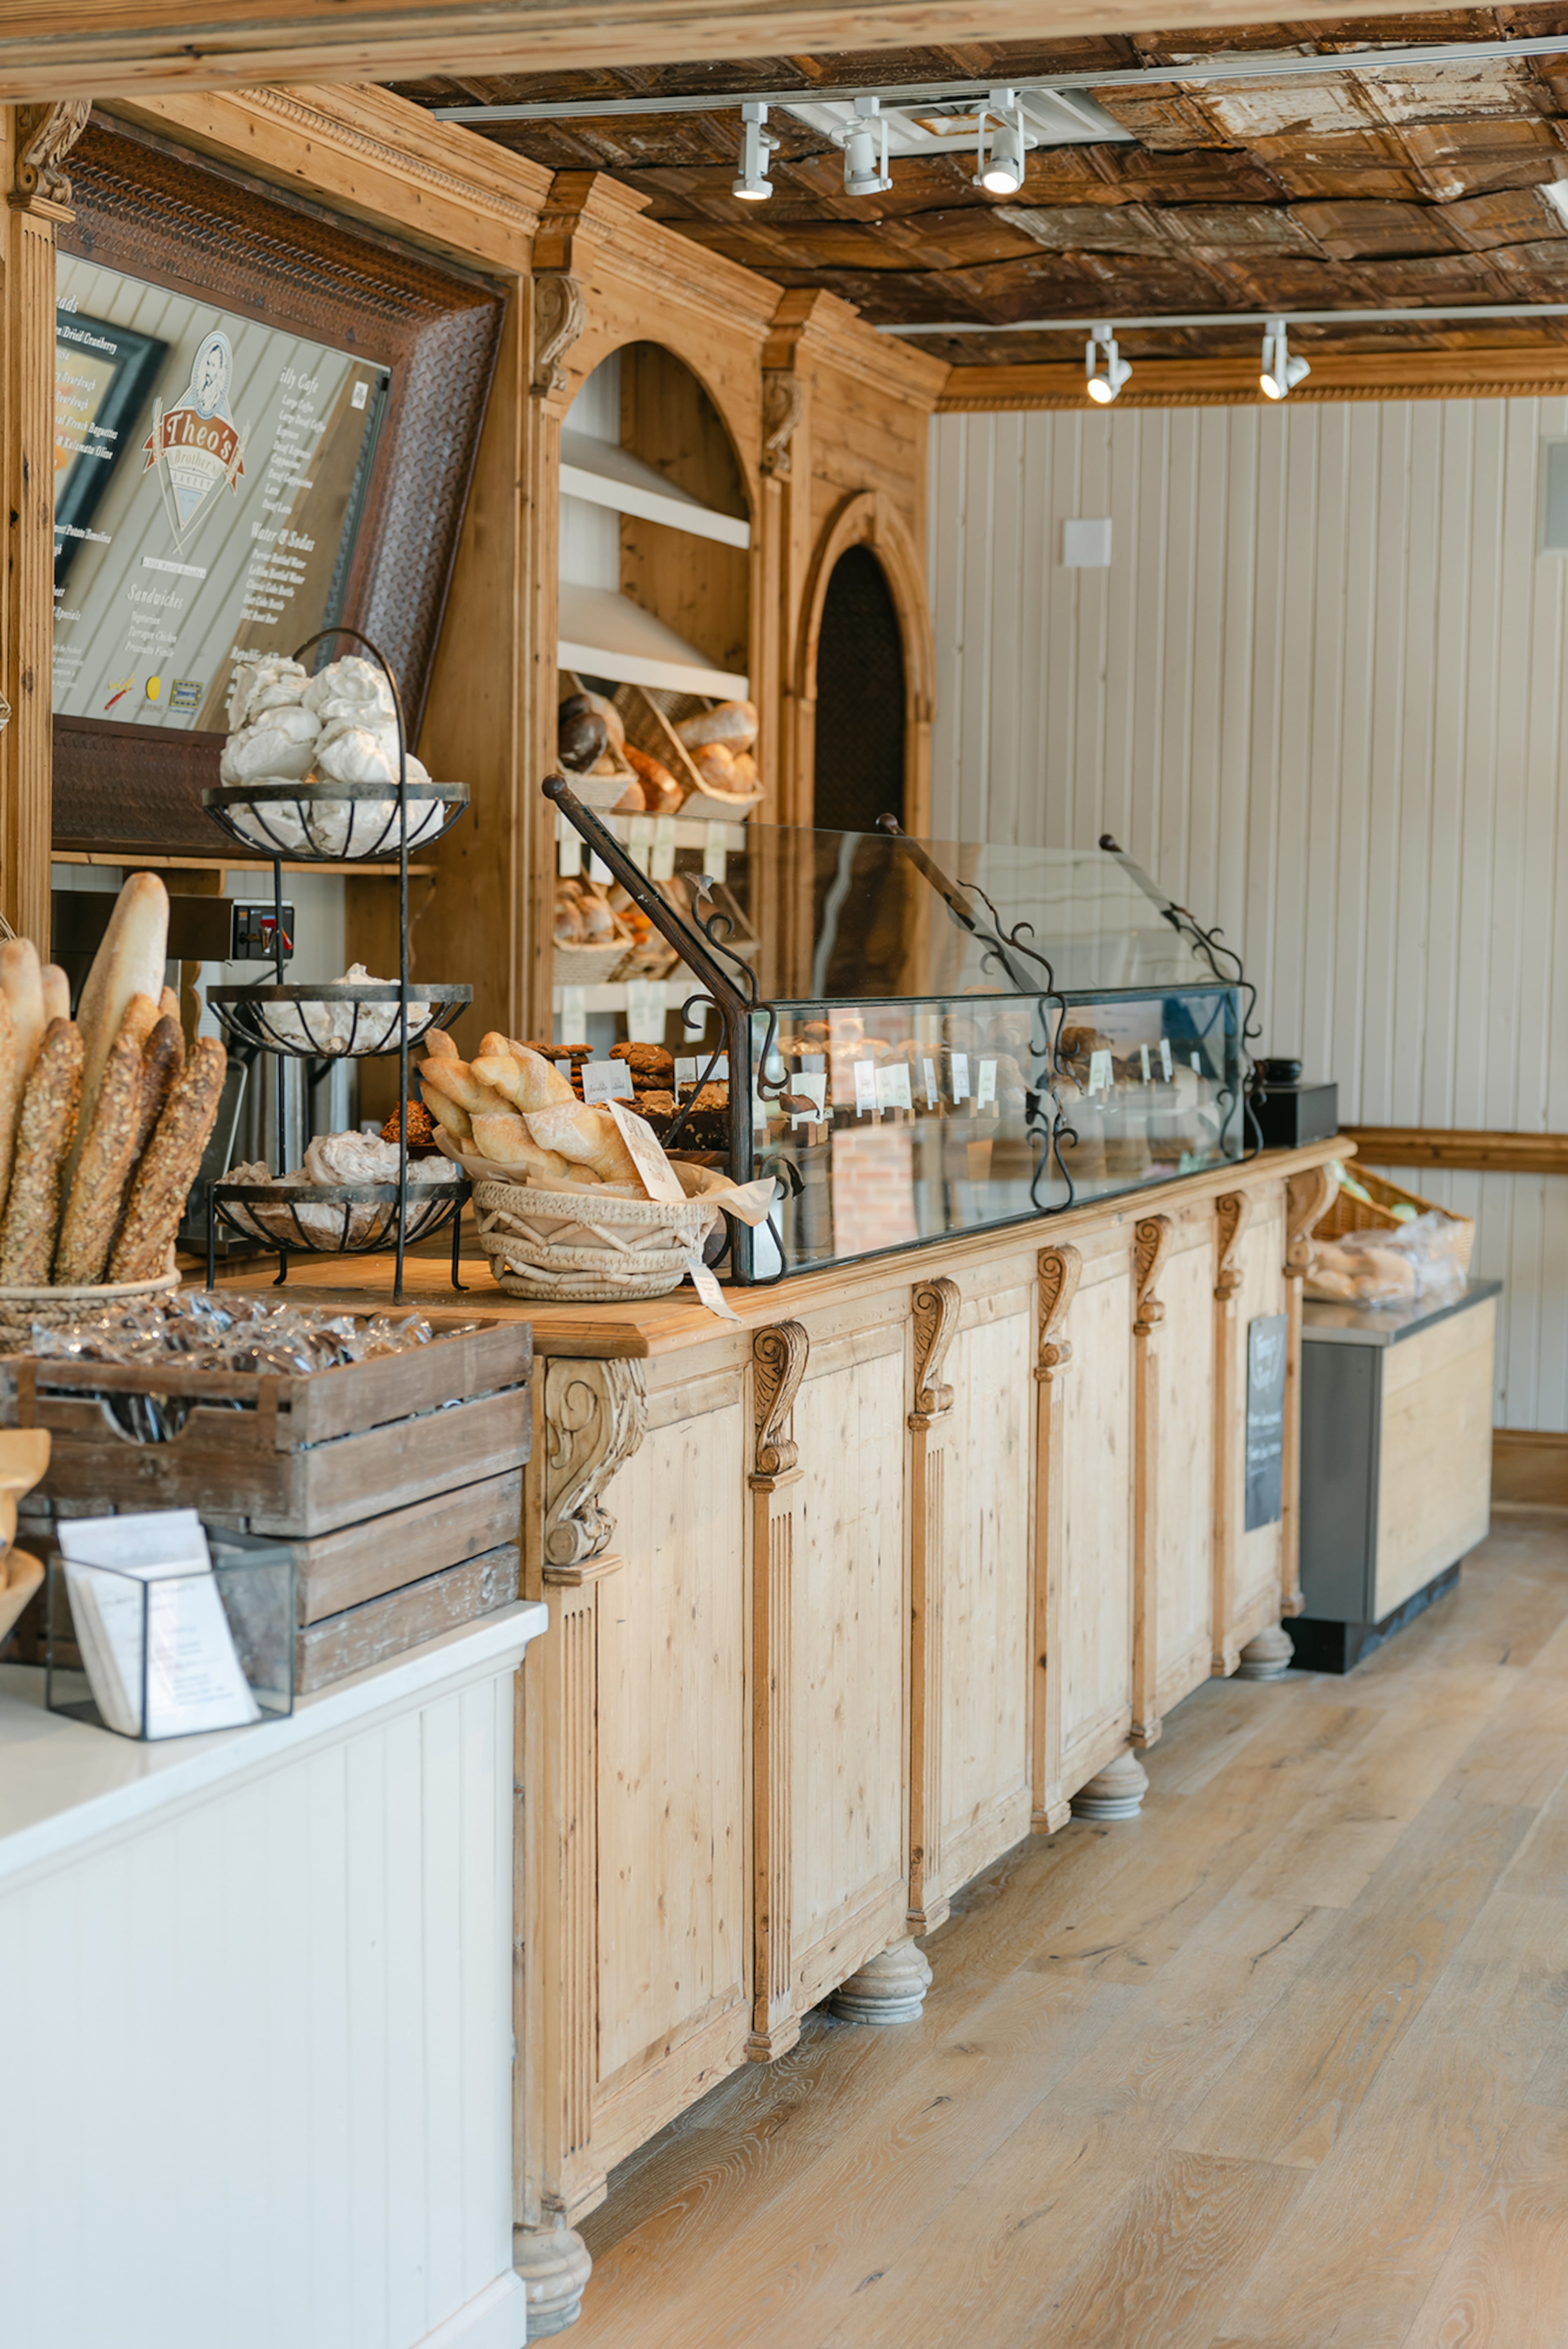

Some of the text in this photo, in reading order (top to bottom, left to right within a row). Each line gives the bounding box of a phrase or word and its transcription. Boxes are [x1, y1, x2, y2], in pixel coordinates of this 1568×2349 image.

[64, 326, 84, 342] Dried
[85, 332, 117, 355] Cranberry
[62, 371, 96, 392] Sourdough
[281, 367, 295, 389] illy
[56, 391, 88, 411] Sourdough
[65, 416, 88, 430] French
[89, 422, 118, 439] Baguettes
[167, 411, 232, 460] Theo's
[63, 437, 94, 454] Kalamata
[95, 445, 113, 460] Olive
[173, 474, 212, 489] BAKERY
[66, 524, 85, 539] Potato
[85, 528, 111, 544] Semolina
[251, 522, 315, 551] Water & Sodas
[128, 583, 183, 609] Sandwiches
[55, 606, 81, 621] Specials
